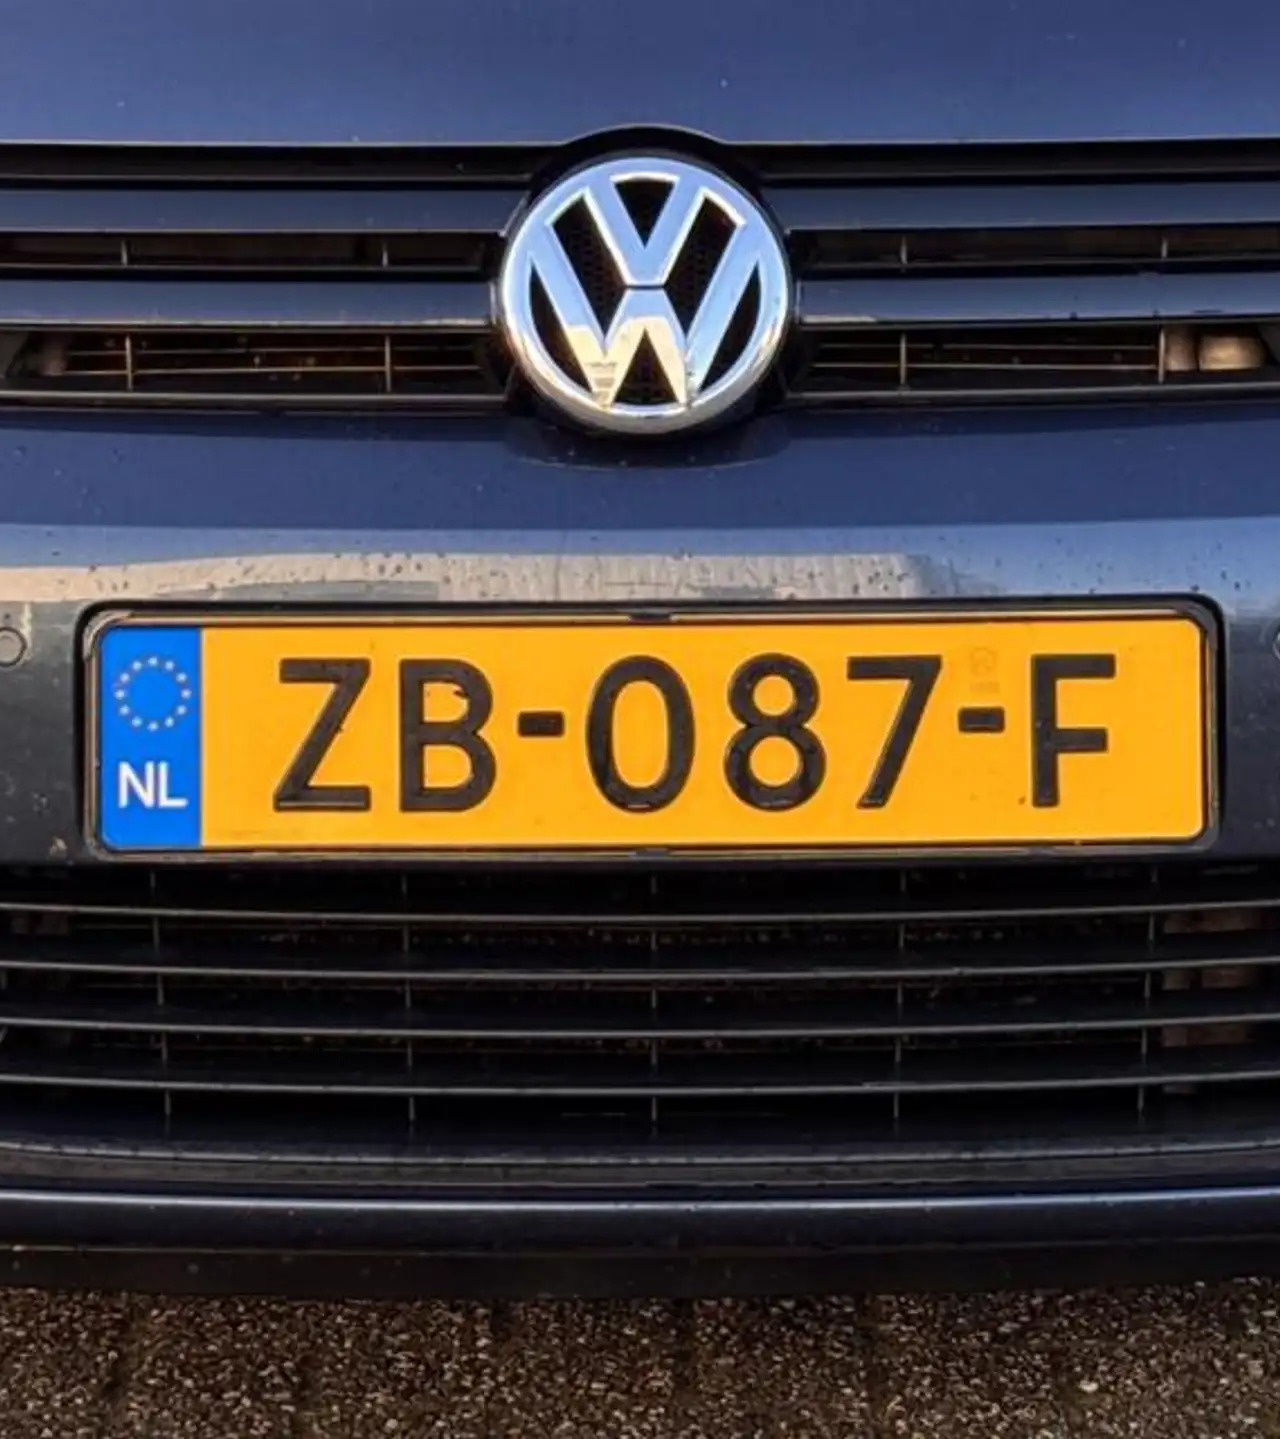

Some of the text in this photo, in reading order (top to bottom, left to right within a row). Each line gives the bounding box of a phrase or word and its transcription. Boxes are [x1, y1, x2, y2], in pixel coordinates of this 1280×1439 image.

[513, 167, 777, 421] VW
[118, 761, 188, 808] NL
[273, 654, 1117, 813] ZB-087-F
